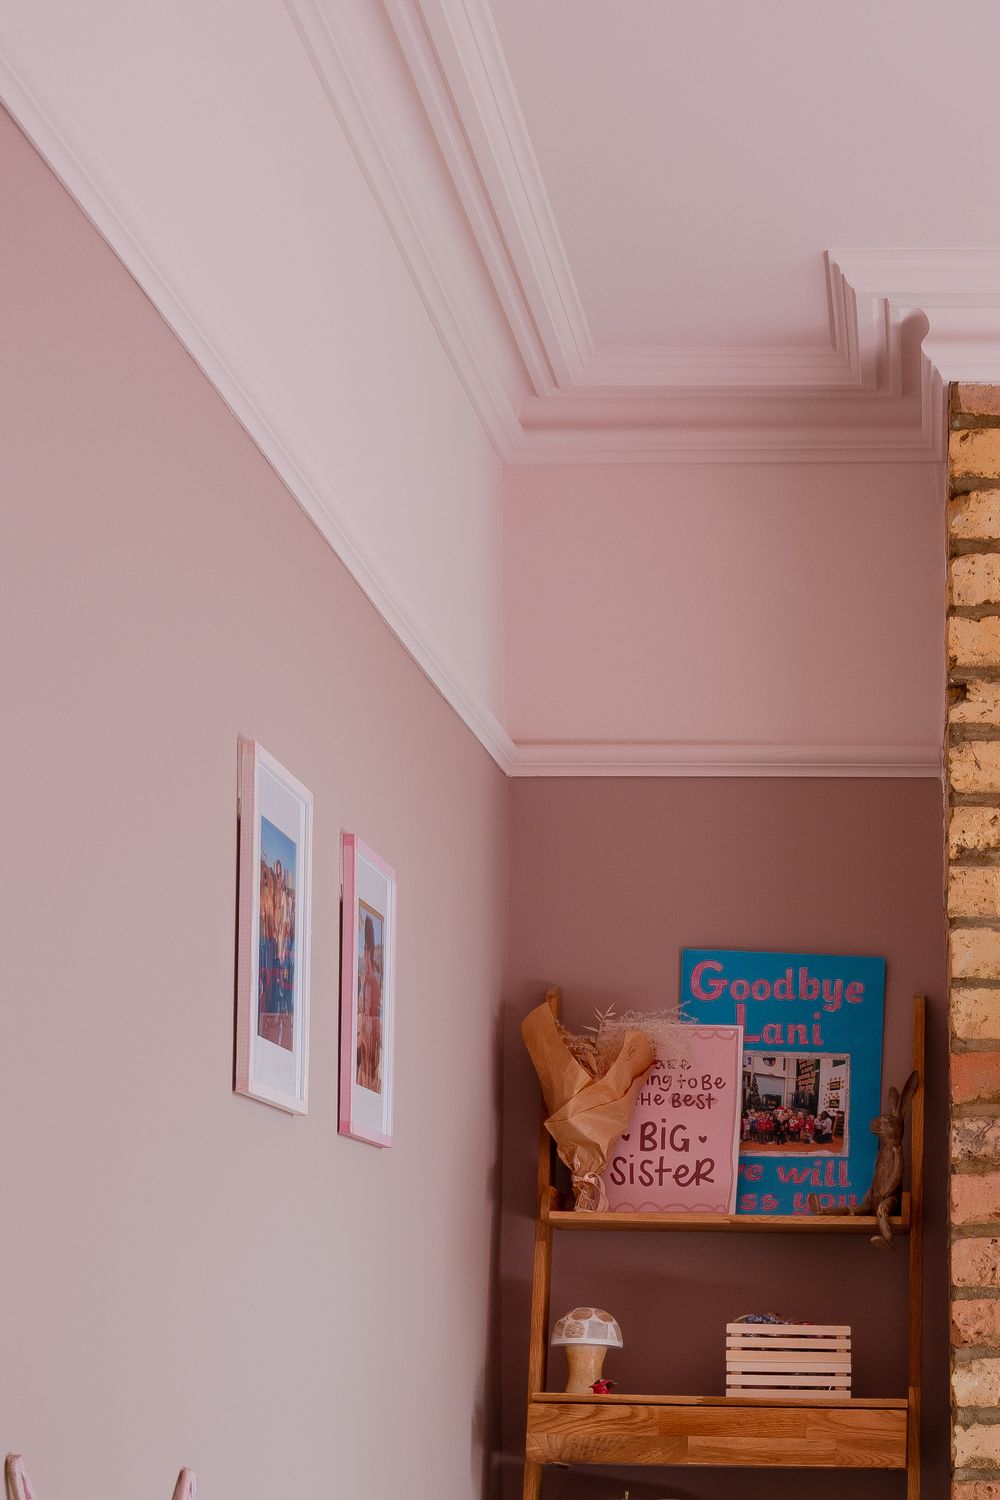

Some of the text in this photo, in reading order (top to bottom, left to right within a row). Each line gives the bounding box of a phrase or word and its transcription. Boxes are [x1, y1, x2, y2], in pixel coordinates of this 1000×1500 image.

[690, 959, 865, 1012] Goodbye
[736, 1003, 824, 1046] Lani
[677, 1073, 698, 1089] to
[701, 1073, 726, 1091] Be
[738, 1159, 852, 1188] e will
[740, 1191, 858, 1216] ss you
